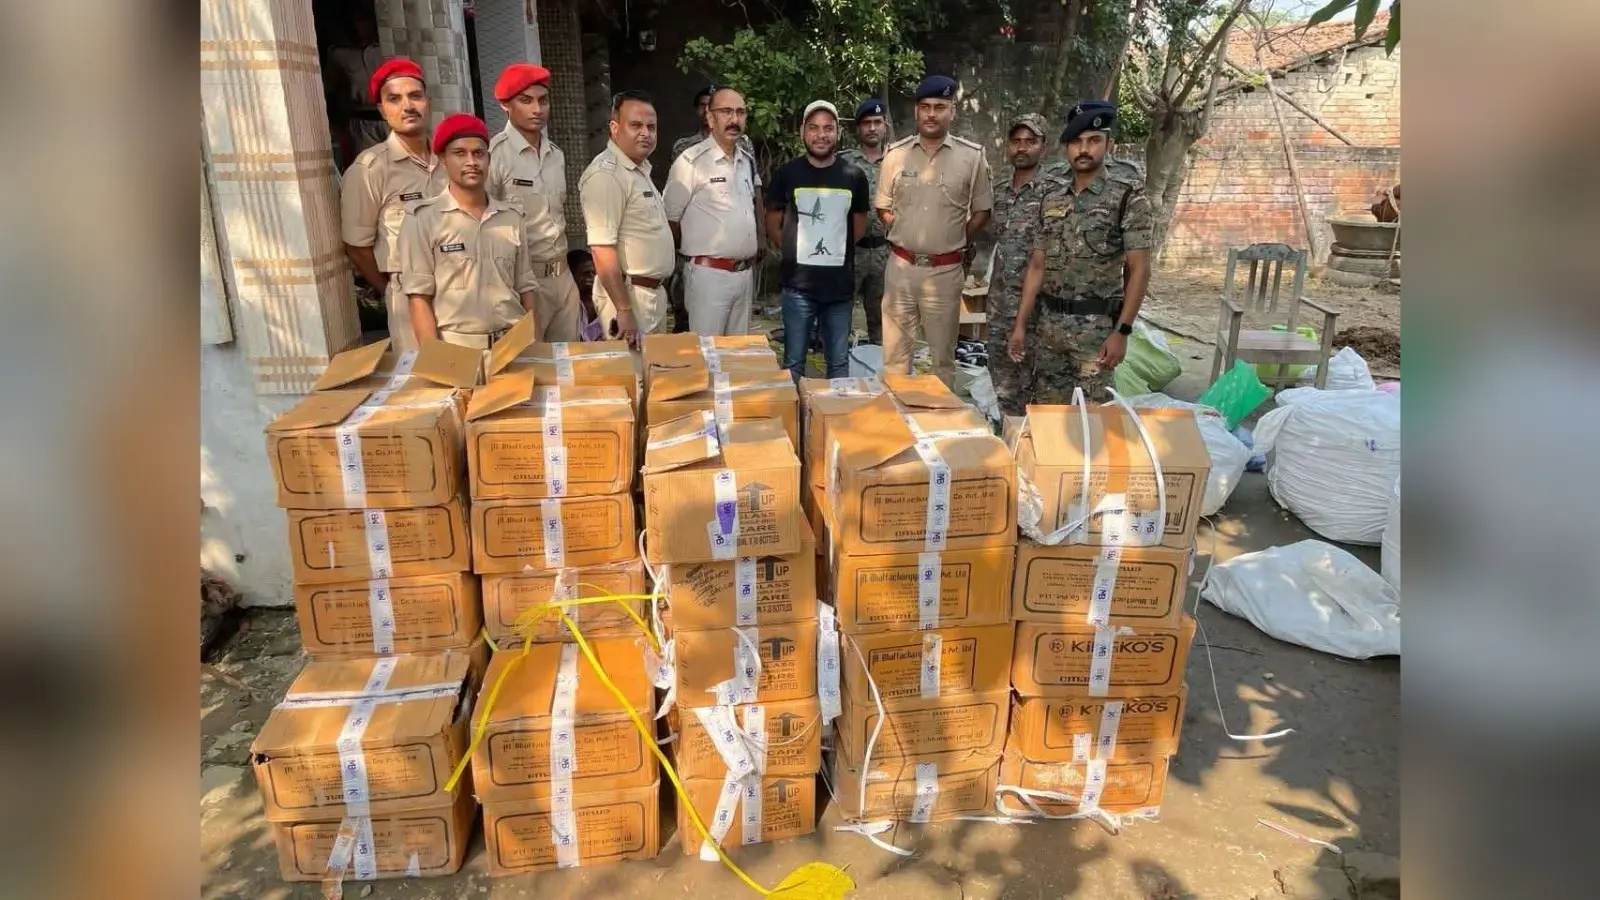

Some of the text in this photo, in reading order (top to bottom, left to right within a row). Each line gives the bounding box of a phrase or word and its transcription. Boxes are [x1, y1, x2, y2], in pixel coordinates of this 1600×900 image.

[761, 493, 776, 505] UP
[776, 565, 790, 576] UP
[782, 644, 796, 655] UP
[1072, 639, 1166, 654] KiKO'S
[792, 721, 805, 731] UP
[787, 787, 800, 798] UP
